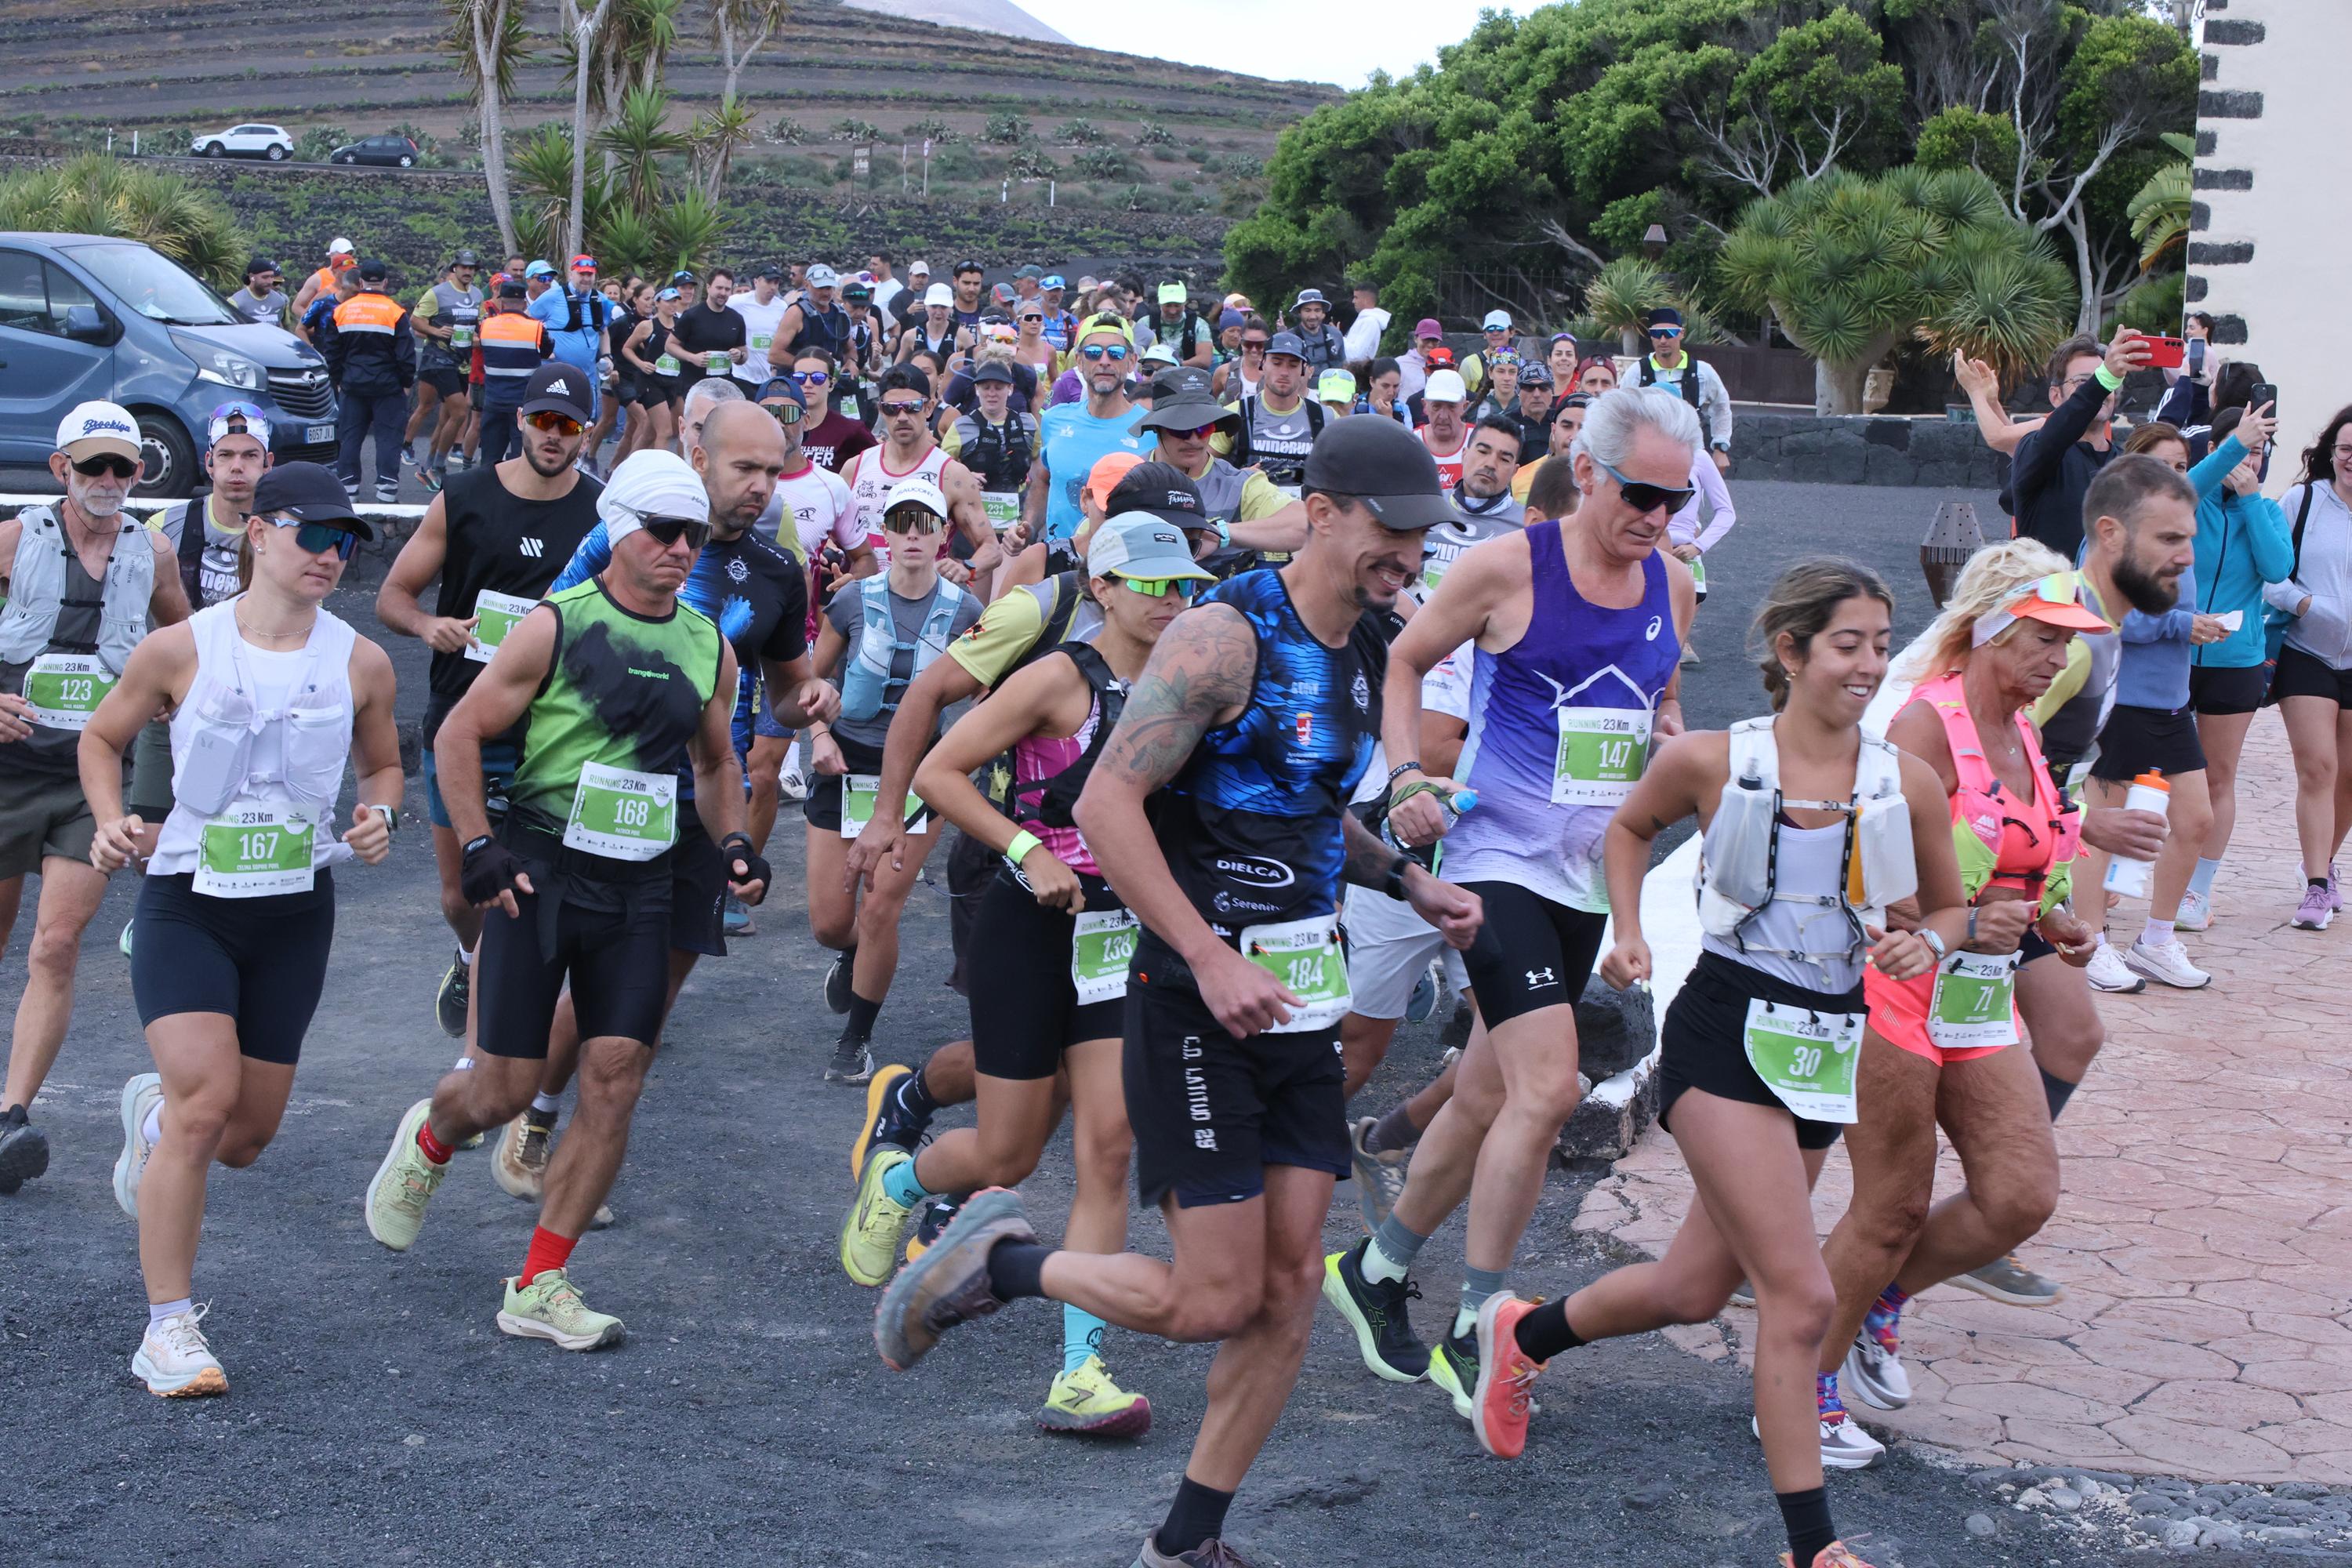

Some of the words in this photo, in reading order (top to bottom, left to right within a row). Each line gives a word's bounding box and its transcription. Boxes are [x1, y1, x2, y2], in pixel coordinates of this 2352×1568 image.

[546, 387, 569, 396] adidas
[308, 426, 323, 438] 6057
[987, 504, 1004, 515] 231
[509, 604, 519, 614] 23
[65, 662, 76, 672] 23
[78, 662, 90, 672] Km
[60, 679, 93, 701] 123
[1603, 719, 1616, 730] 23
[1617, 720, 1629, 731] Km
[1599, 740, 1632, 768] 147
[589, 775, 621, 788] RUNNING
[622, 779, 634, 790] 23
[634, 781, 647, 792] Km
[241, 812, 256, 824] 23
[258, 812, 274, 823] Km
[613, 798, 649, 826] 168
[239, 832, 280, 861] 167
[1217, 859, 1281, 879] DIELCA
[1109, 916, 1121, 928] 23
[1294, 933, 1305, 947] 23
[1307, 931, 1319, 945] Km
[1287, 956, 1325, 990] 184
[1980, 964, 1993, 976] 23
[1973, 985, 1995, 1011] 71
[1797, 1021, 1813, 1036] 23
[1813, 1024, 1830, 1038] Km
[1788, 1046, 1822, 1077] 30
[1185, 1067, 1212, 1121] LATITUD
